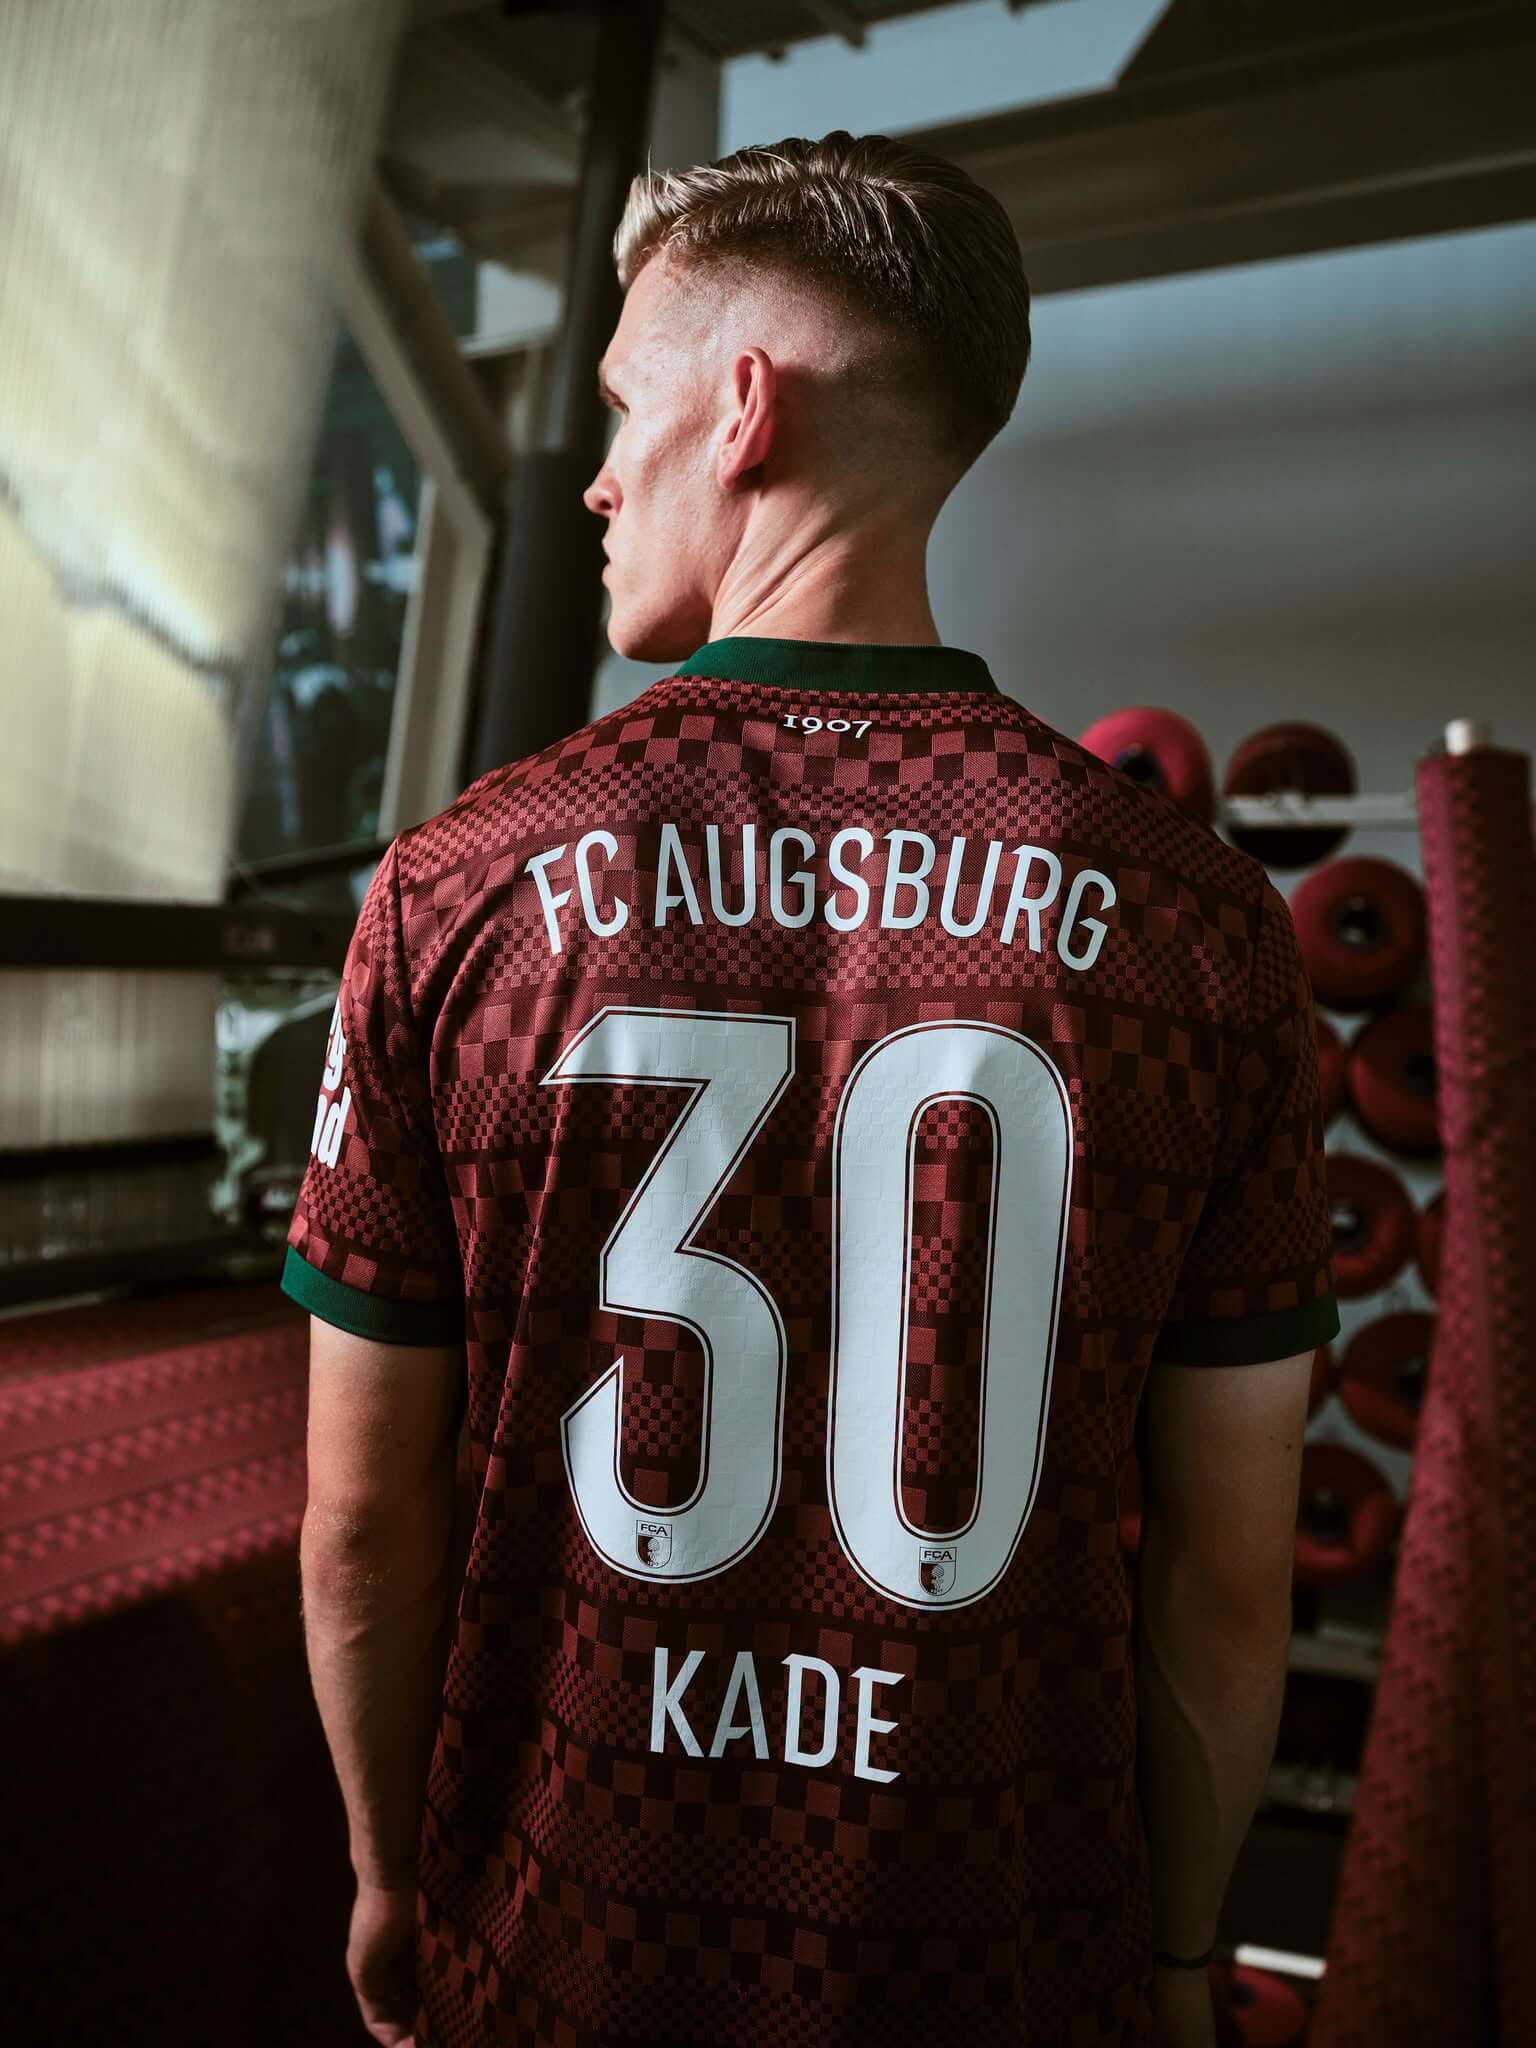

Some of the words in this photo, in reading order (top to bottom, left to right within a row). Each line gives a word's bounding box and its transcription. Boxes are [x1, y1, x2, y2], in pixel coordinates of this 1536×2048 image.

[783, 714, 873, 739] 1907
[523, 829, 629, 956] FC
[654, 823, 1117, 971] AUGSBURG
[539, 1006, 1074, 1611] 30
[640, 1523, 668, 1537] FCA
[924, 1550, 953, 1561] FCA
[650, 1646, 906, 1784] KADE
